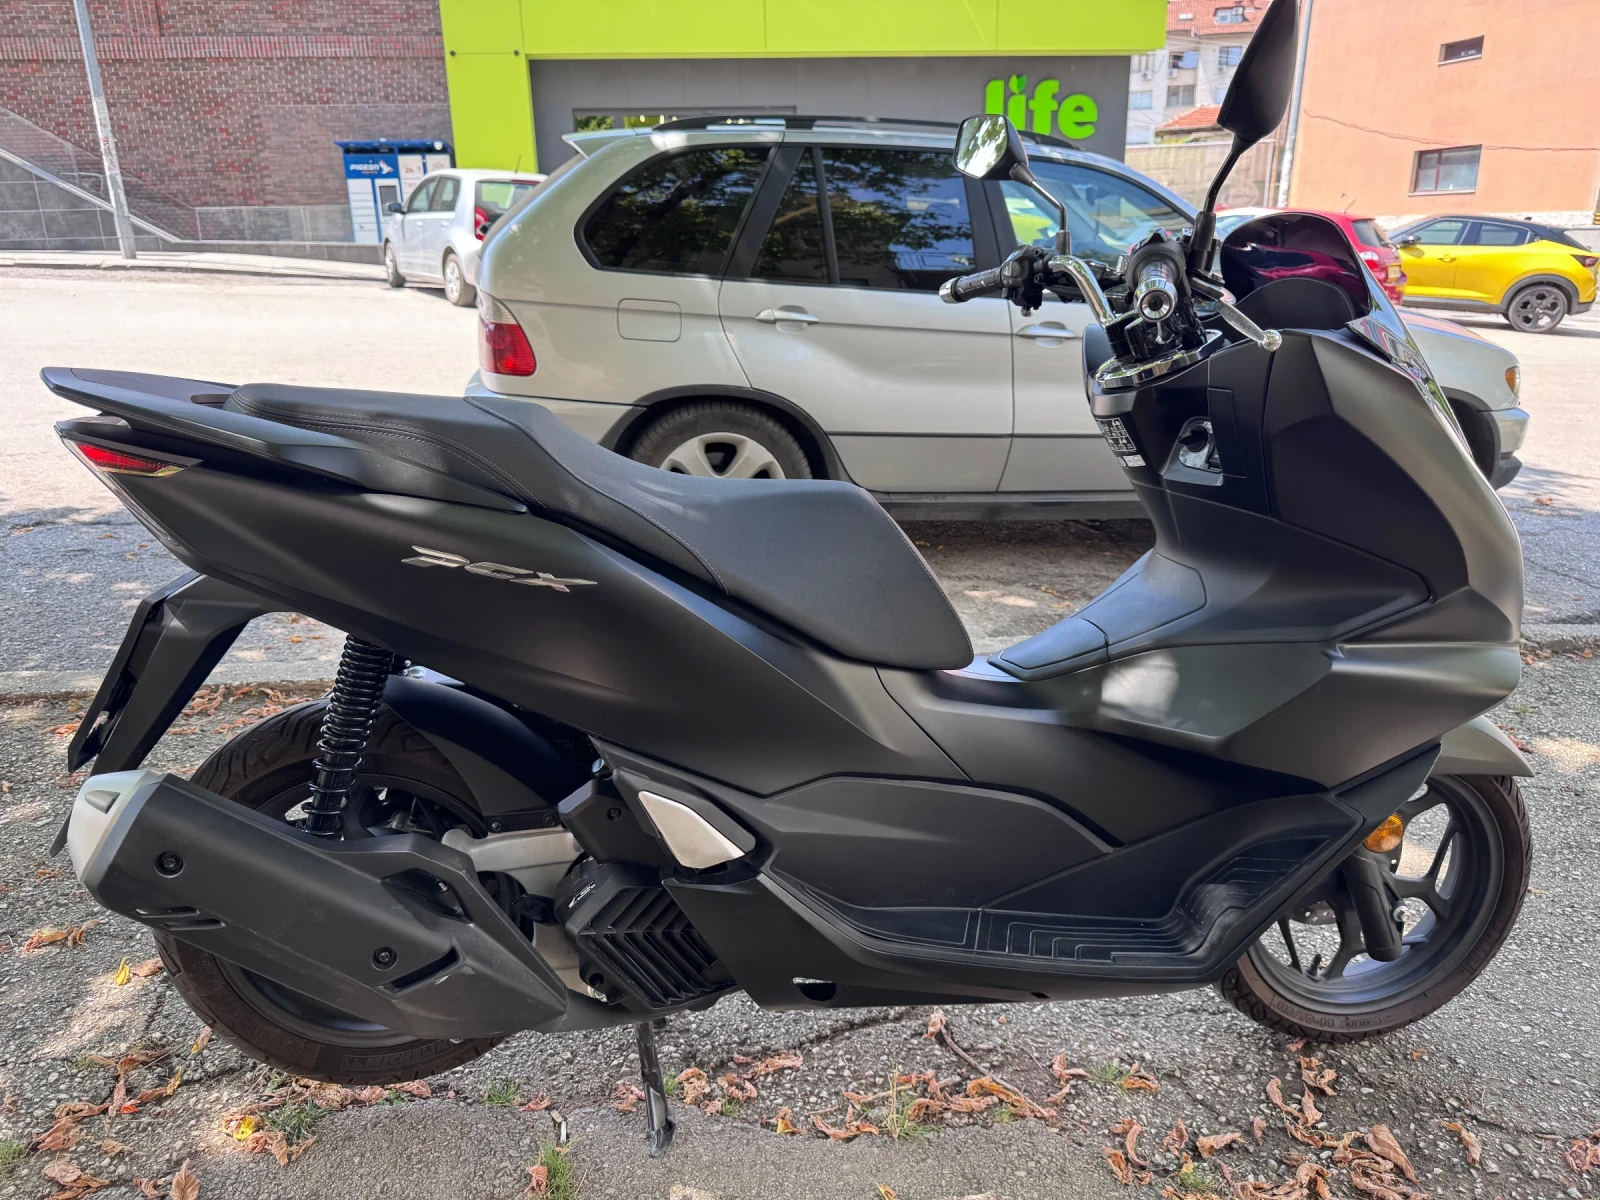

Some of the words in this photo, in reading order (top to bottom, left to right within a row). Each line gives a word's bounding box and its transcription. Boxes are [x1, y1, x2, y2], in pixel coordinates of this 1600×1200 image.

[985, 74, 1098, 139] life
[401, 545, 598, 592] PCX
[364, 1039, 449, 1068] MICHELIN
